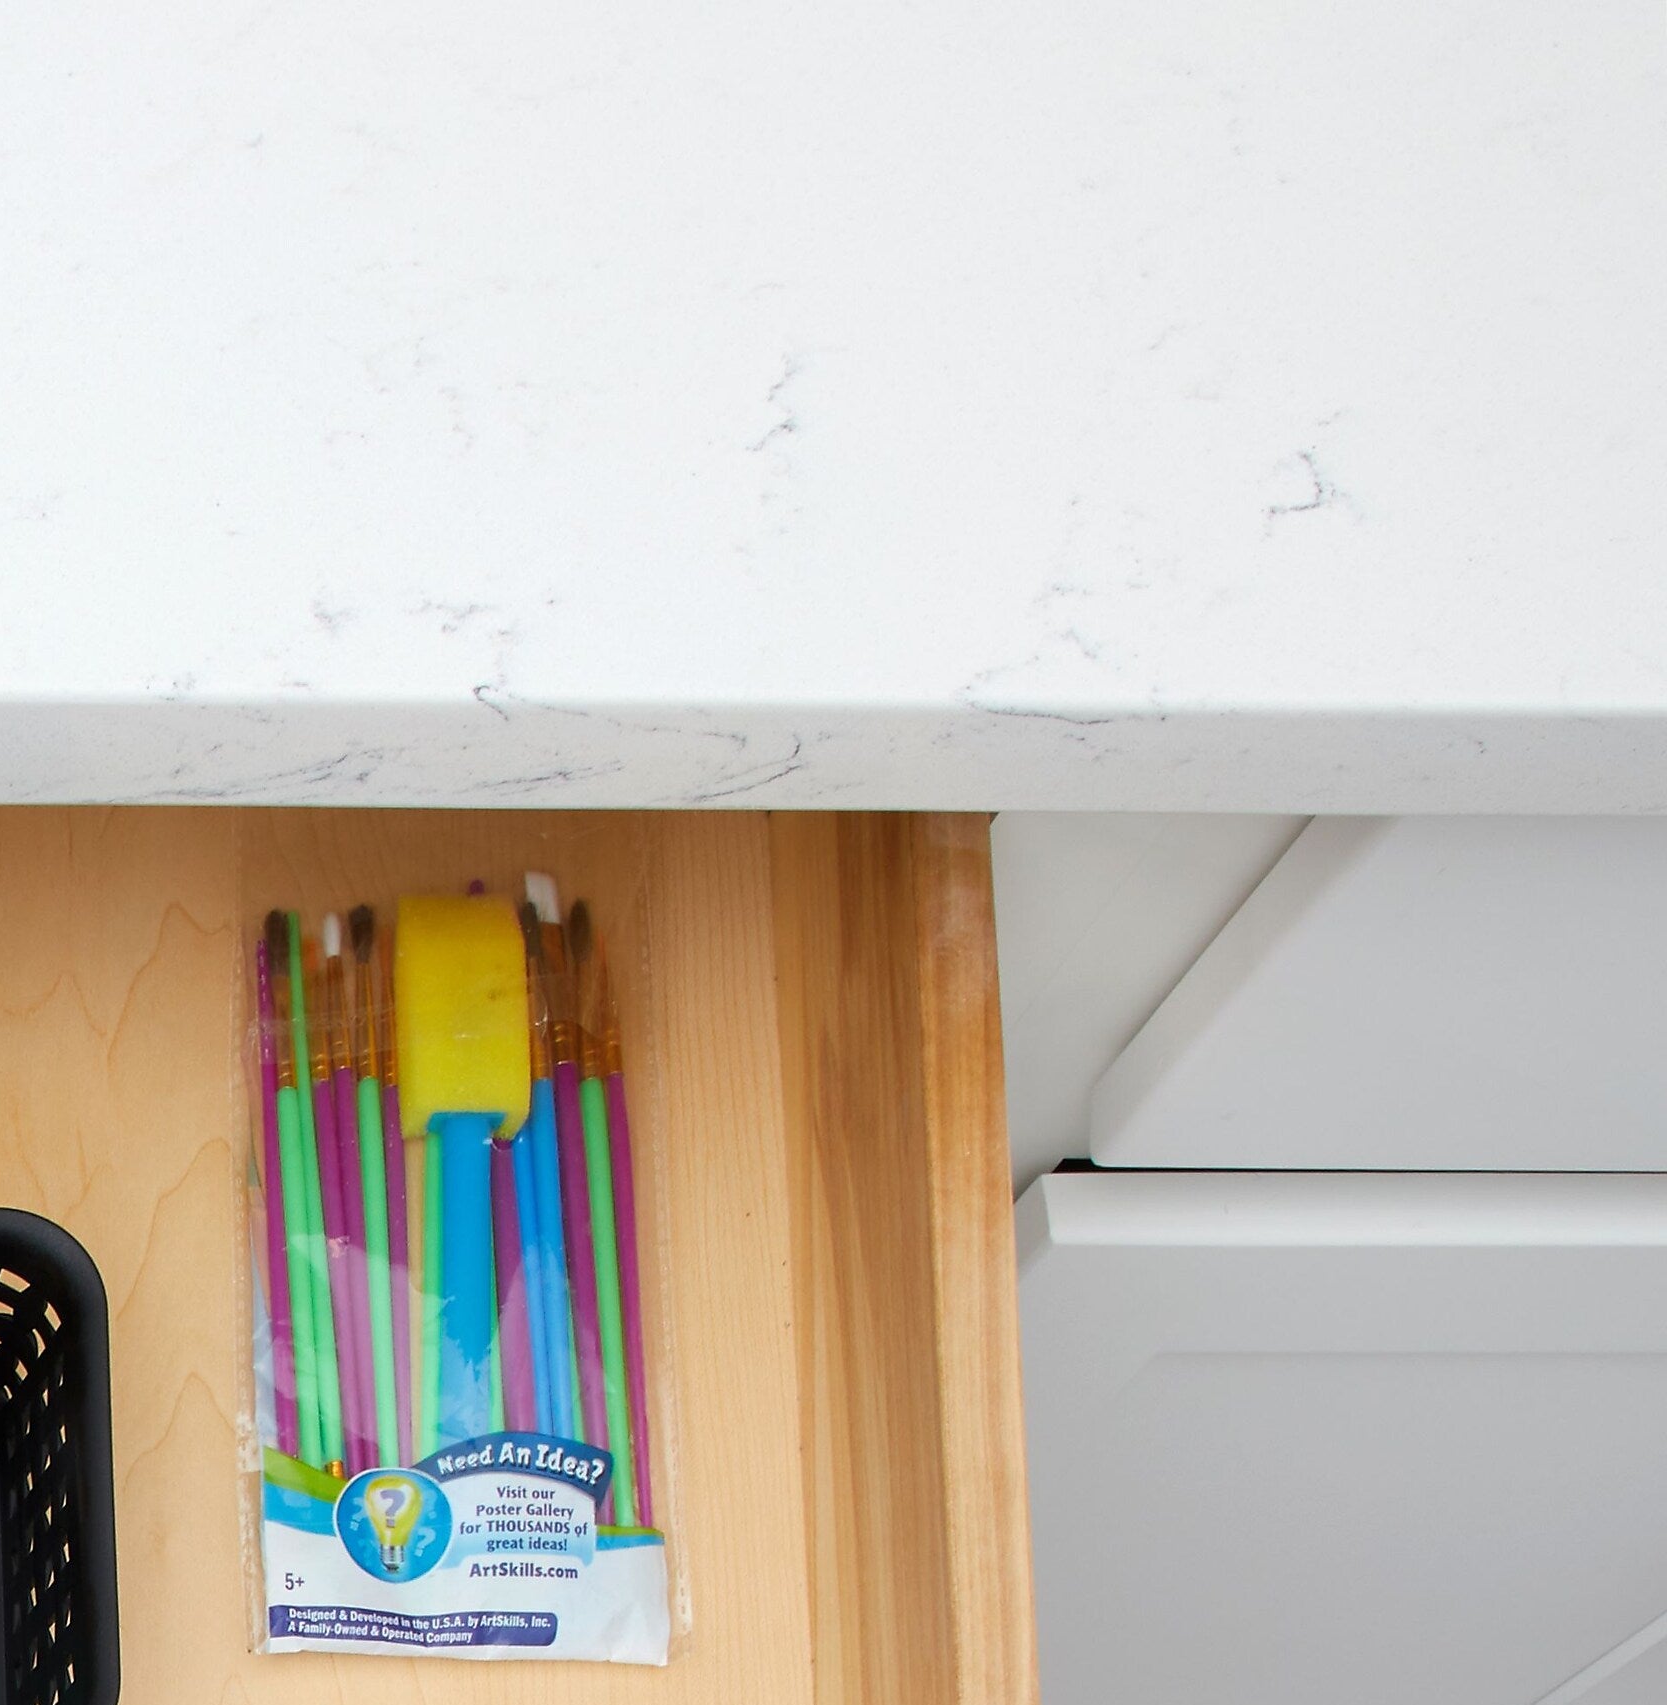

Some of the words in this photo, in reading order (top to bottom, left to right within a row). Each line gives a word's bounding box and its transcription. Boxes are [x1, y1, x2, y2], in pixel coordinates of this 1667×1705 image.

[437, 1444, 493, 1475] Need
[498, 1442, 532, 1466] An
[535, 1444, 606, 1485] Idea?
[497, 1486, 526, 1499] Visit
[532, 1489, 555, 1500] our
[476, 1504, 522, 1517] Poster
[526, 1504, 574, 1521] Gallery
[460, 1522, 481, 1535] for
[487, 1520, 570, 1535] THOUSANDS
[574, 1522, 589, 1537] of
[487, 1538, 524, 1552] great
[528, 1537, 568, 1551] ideas!
[469, 1562, 578, 1579] ArtSkills.com
[285, 1573, 305, 1590] 5+
[288, 1608, 336, 1624] Designed
[338, 1610, 348, 1620] &
[350, 1611, 399, 1629] Developed
[401, 1617, 410, 1628] in
[412, 1618, 430, 1630] the
[432, 1617, 465, 1630] U.S.A.
[468, 1615, 479, 1629] by
[480, 1615, 529, 1629] ArtSkills,
[531, 1616, 551, 1628] Inc.
[288, 1621, 296, 1632] A
[298, 1622, 368, 1637] Family-Owned
[370, 1626, 379, 1637] &
[381, 1627, 424, 1643] Operated
[426, 1632, 473, 1645] Company
